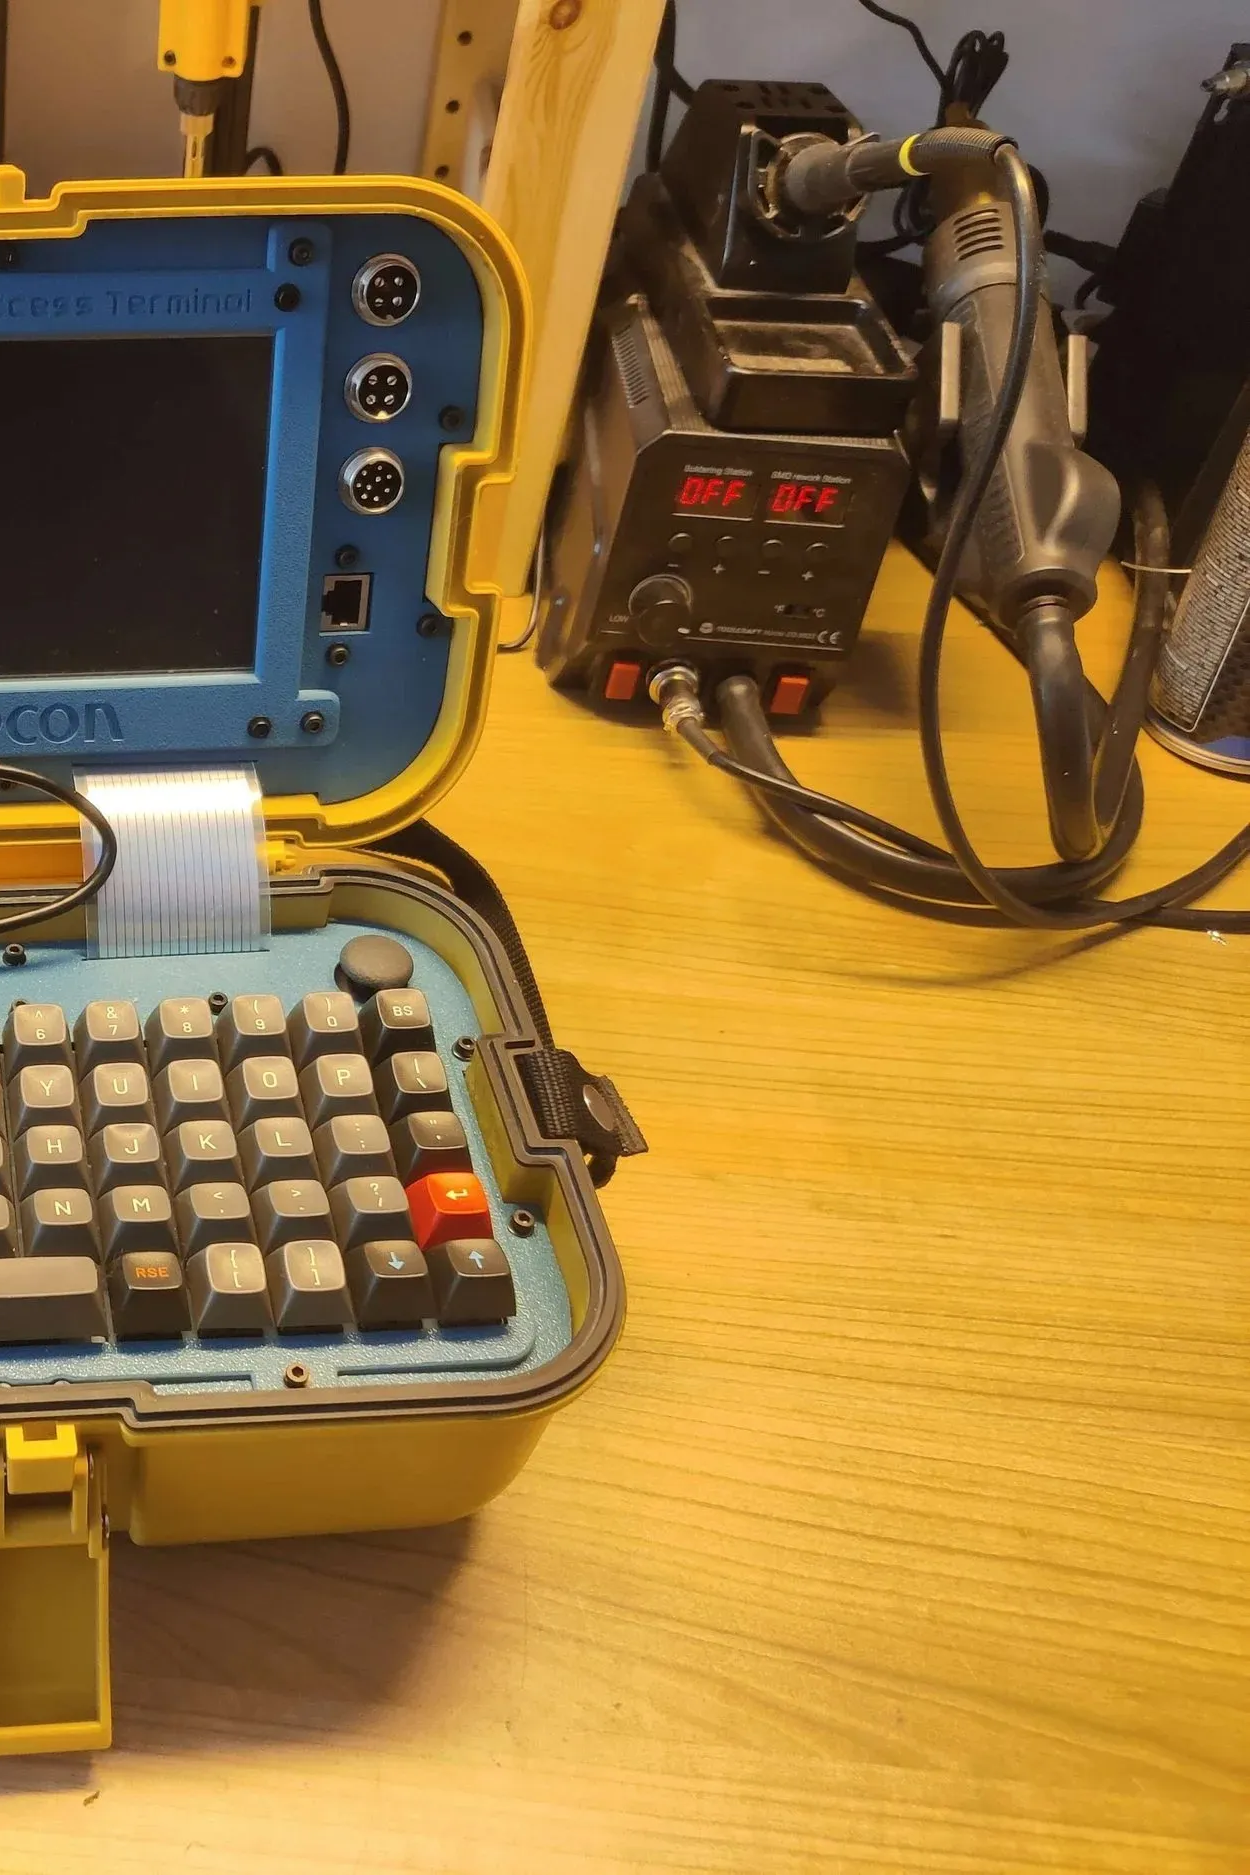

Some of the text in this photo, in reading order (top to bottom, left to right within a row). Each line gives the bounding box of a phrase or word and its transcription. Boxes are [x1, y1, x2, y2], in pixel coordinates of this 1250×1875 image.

[106, 287, 254, 316] Terminal
[680, 477, 746, 506] OFF
[772, 484, 839, 513] OFF
[392, 1005, 413, 1017] BS
[182, 1022, 192, 1033] 8
[255, 1018, 265, 1030] 9
[326, 1016, 337, 1027] 0
[36, 1028, 46, 1041] 6
[109, 1024, 118, 1036] 7
[262, 1071, 277, 1088] O
[336, 1069, 351, 1085] P
[39, 1079, 54, 1096] Y
[112, 1077, 128, 1094] U
[47, 1139, 62, 1153] H
[124, 1139, 139, 1154] J
[198, 1134, 215, 1150] K
[276, 1131, 292, 1147] L
[54, 1201, 72, 1217] N
[132, 1198, 151, 1214] M
[136, 1266, 169, 1279] RSE
